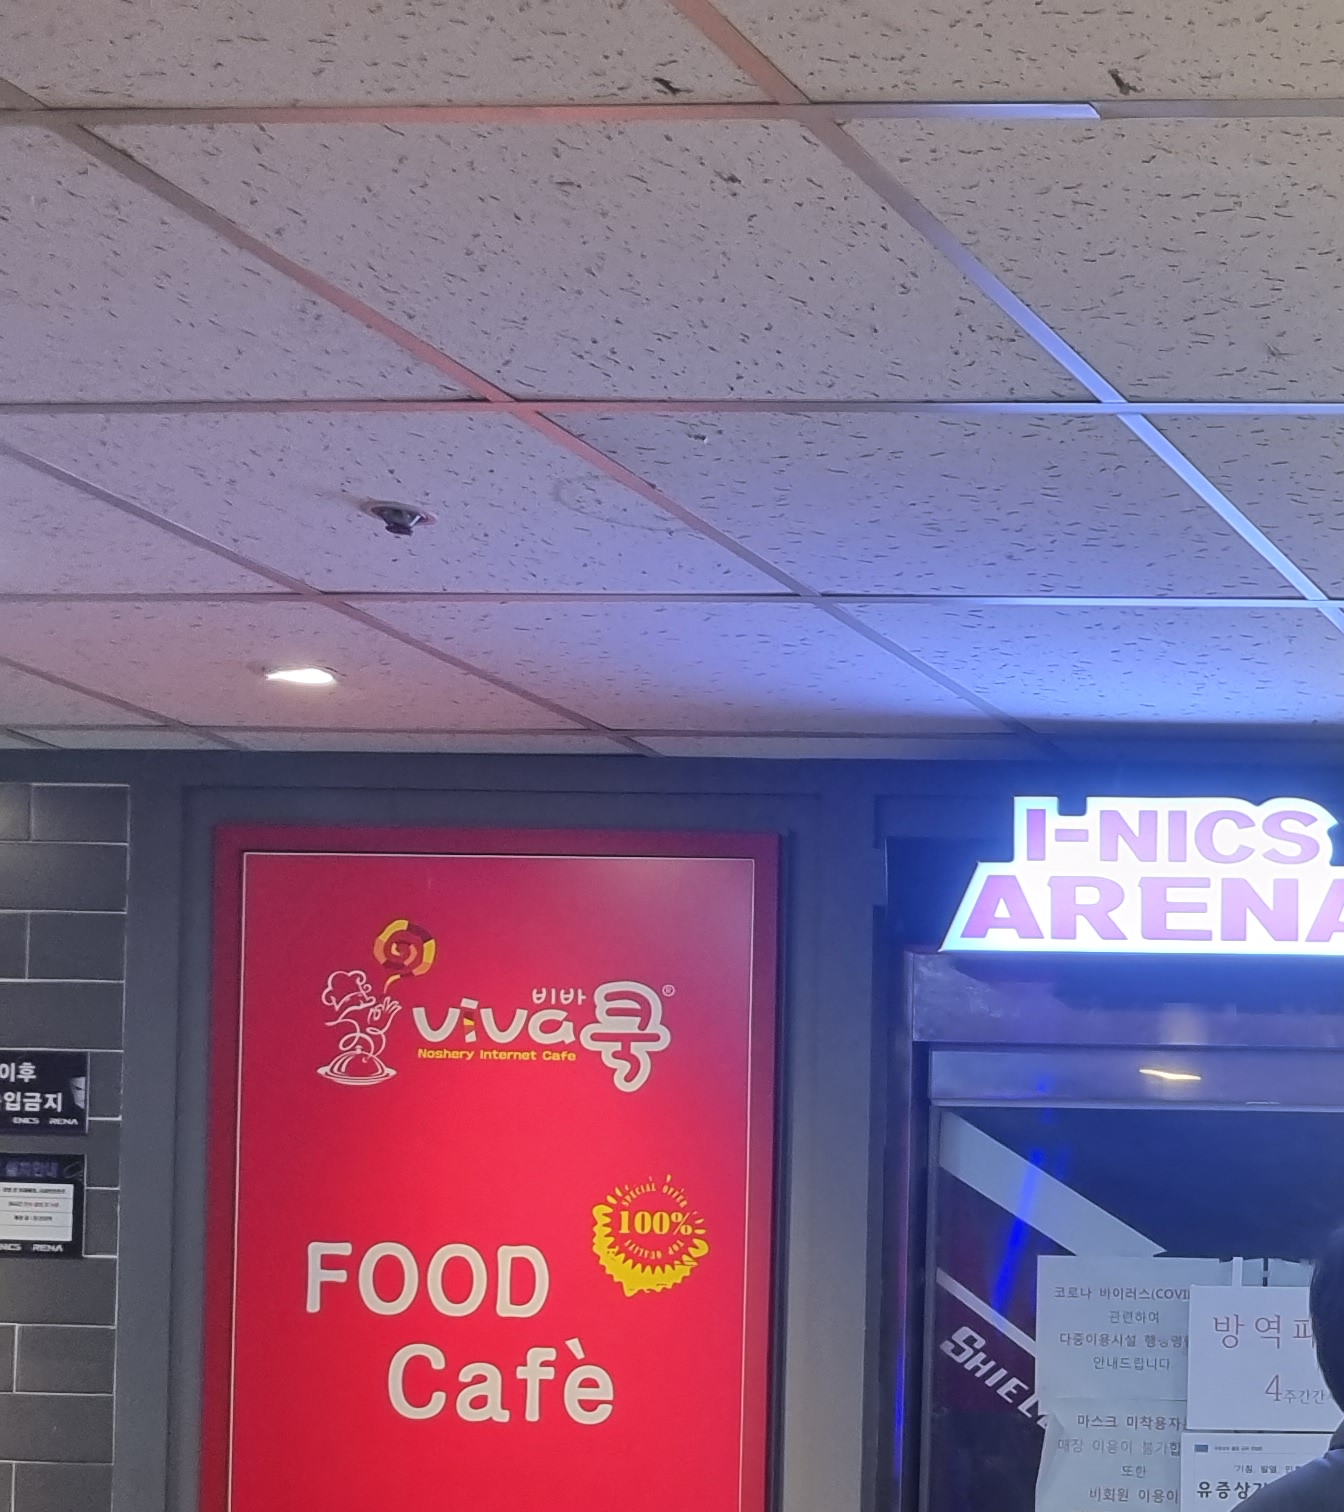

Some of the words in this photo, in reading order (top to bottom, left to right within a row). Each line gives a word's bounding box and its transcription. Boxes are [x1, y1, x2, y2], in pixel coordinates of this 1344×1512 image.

[1025, 808, 1322, 862] I-NICS
[532, 987, 587, 1006] 비바
[417, 1047, 475, 1062] Noshery
[480, 1049, 537, 1062] Internet
[542, 1050, 577, 1062] Cafe
[0, 1092, 62, 1113] 입금지
[618, 1210, 693, 1236] 100%
[306, 1241, 550, 1318] FOOD
[1054, 1286, 1092, 1300] 코로나
[1099, 1287, 1190, 1301] 바이러스(COVI
[1109, 1310, 1160, 1325] 관련하여
[1059, 1332, 1137, 1348] 다중이용시설
[1092, 1356, 1171, 1371] 안내드립니다
[1077, 1414, 1118, 1429] 마스크
[1126, 1415, 1186, 1432] 미착용자
[1092, 1439, 1133, 1455] 이용이
[1120, 1465, 1147, 1479] 또한
[1089, 1487, 1129, 1502] 비회원
[1138, 1489, 1179, 1505] 이용이
